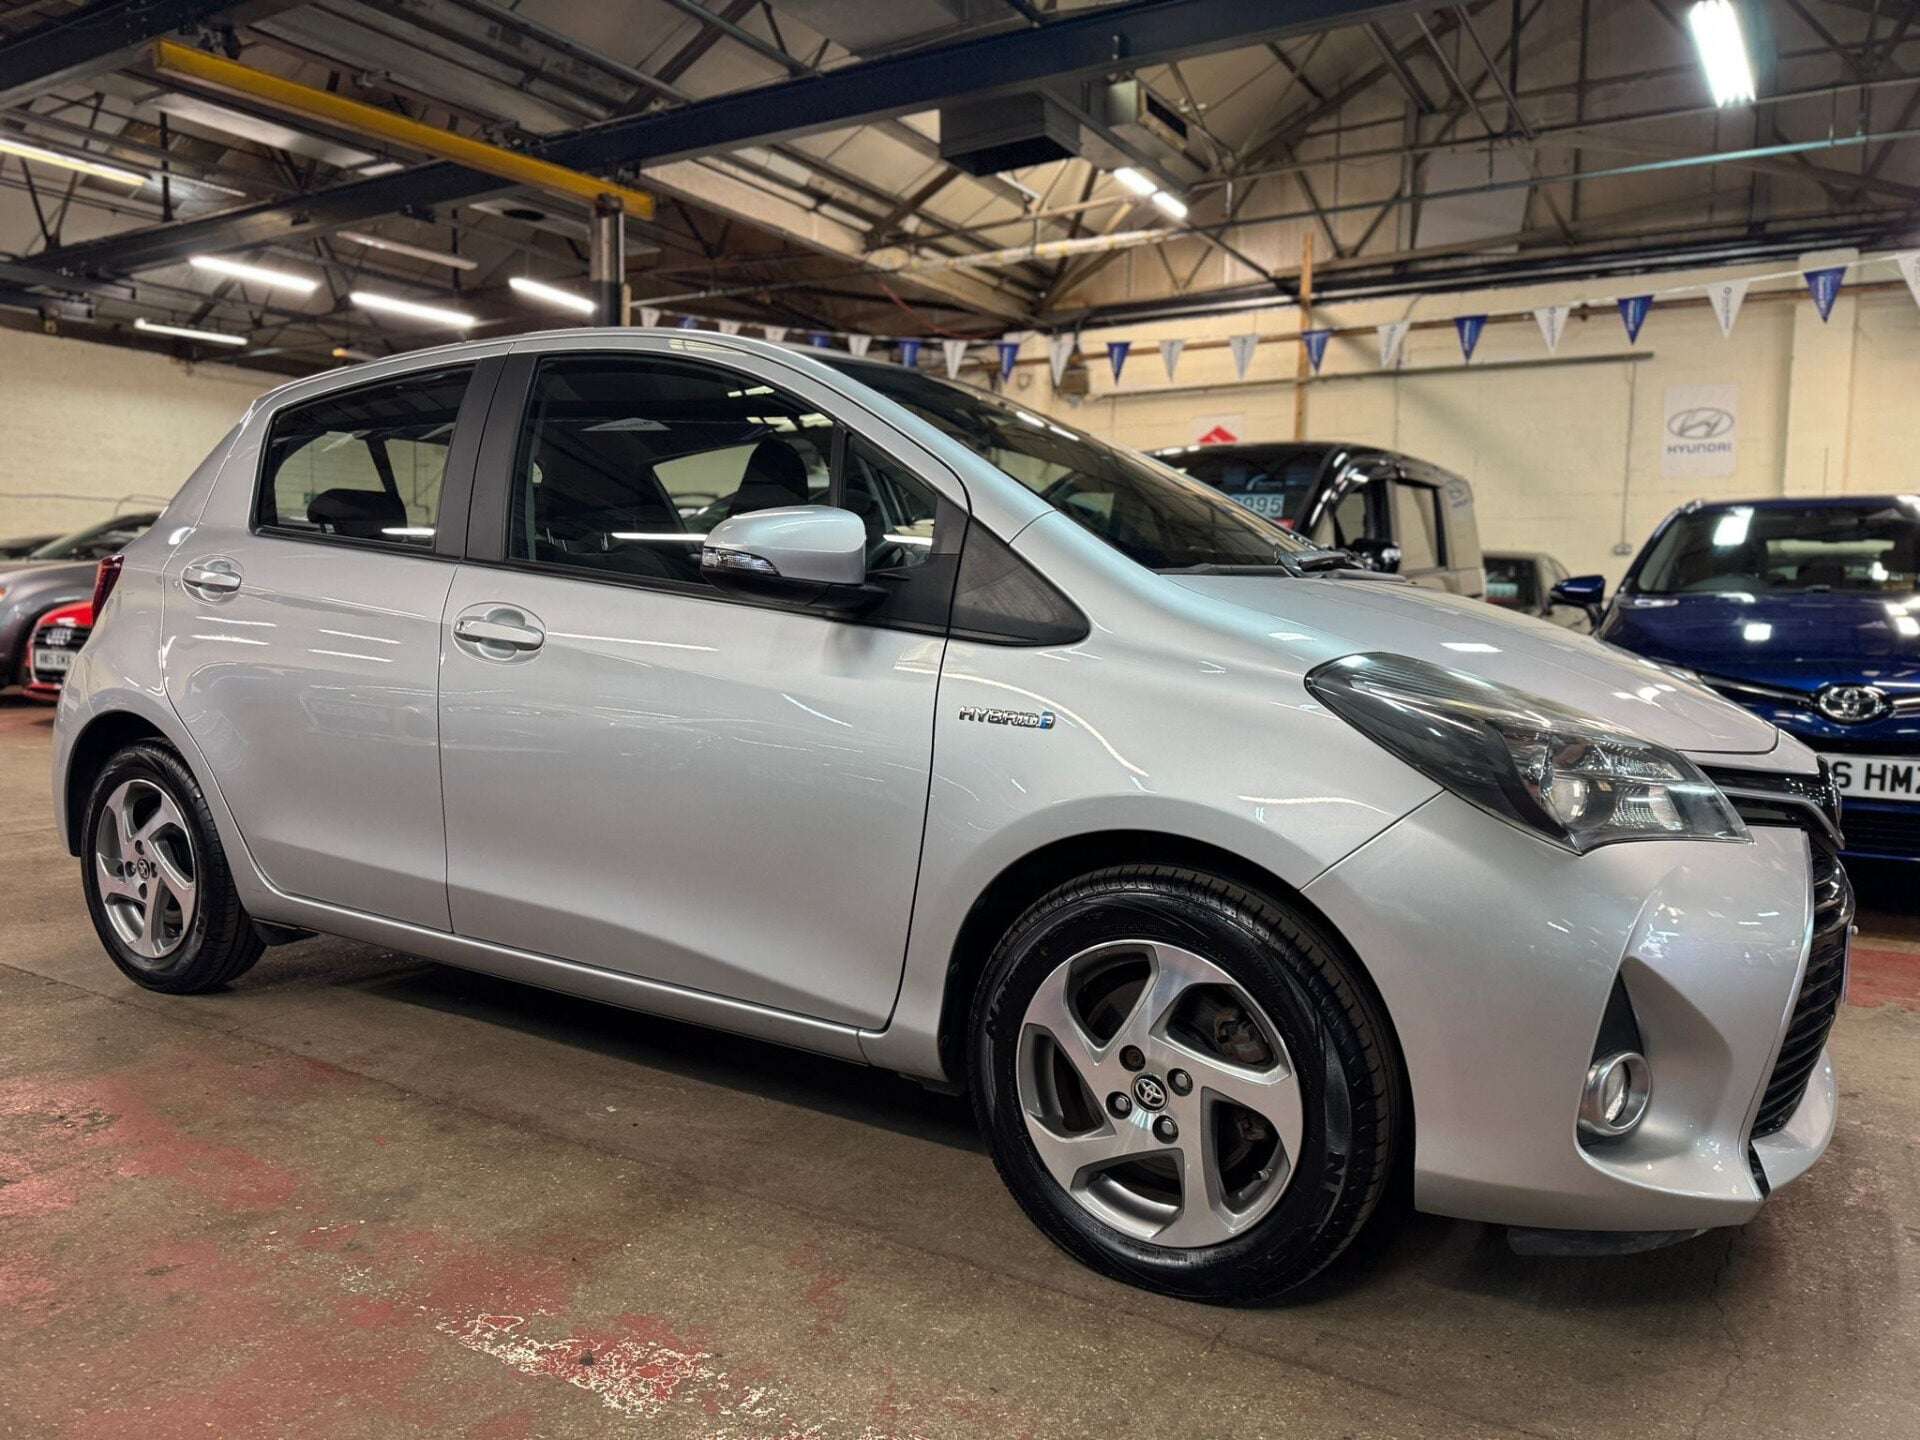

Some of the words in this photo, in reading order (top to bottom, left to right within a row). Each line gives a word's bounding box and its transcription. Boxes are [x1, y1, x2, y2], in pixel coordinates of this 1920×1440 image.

[1666, 442, 1732, 454] HYUNDAI
[1235, 496, 1281, 513] 995
[959, 705, 1042, 729] HYBRID
[1864, 763, 1920, 794] HM
